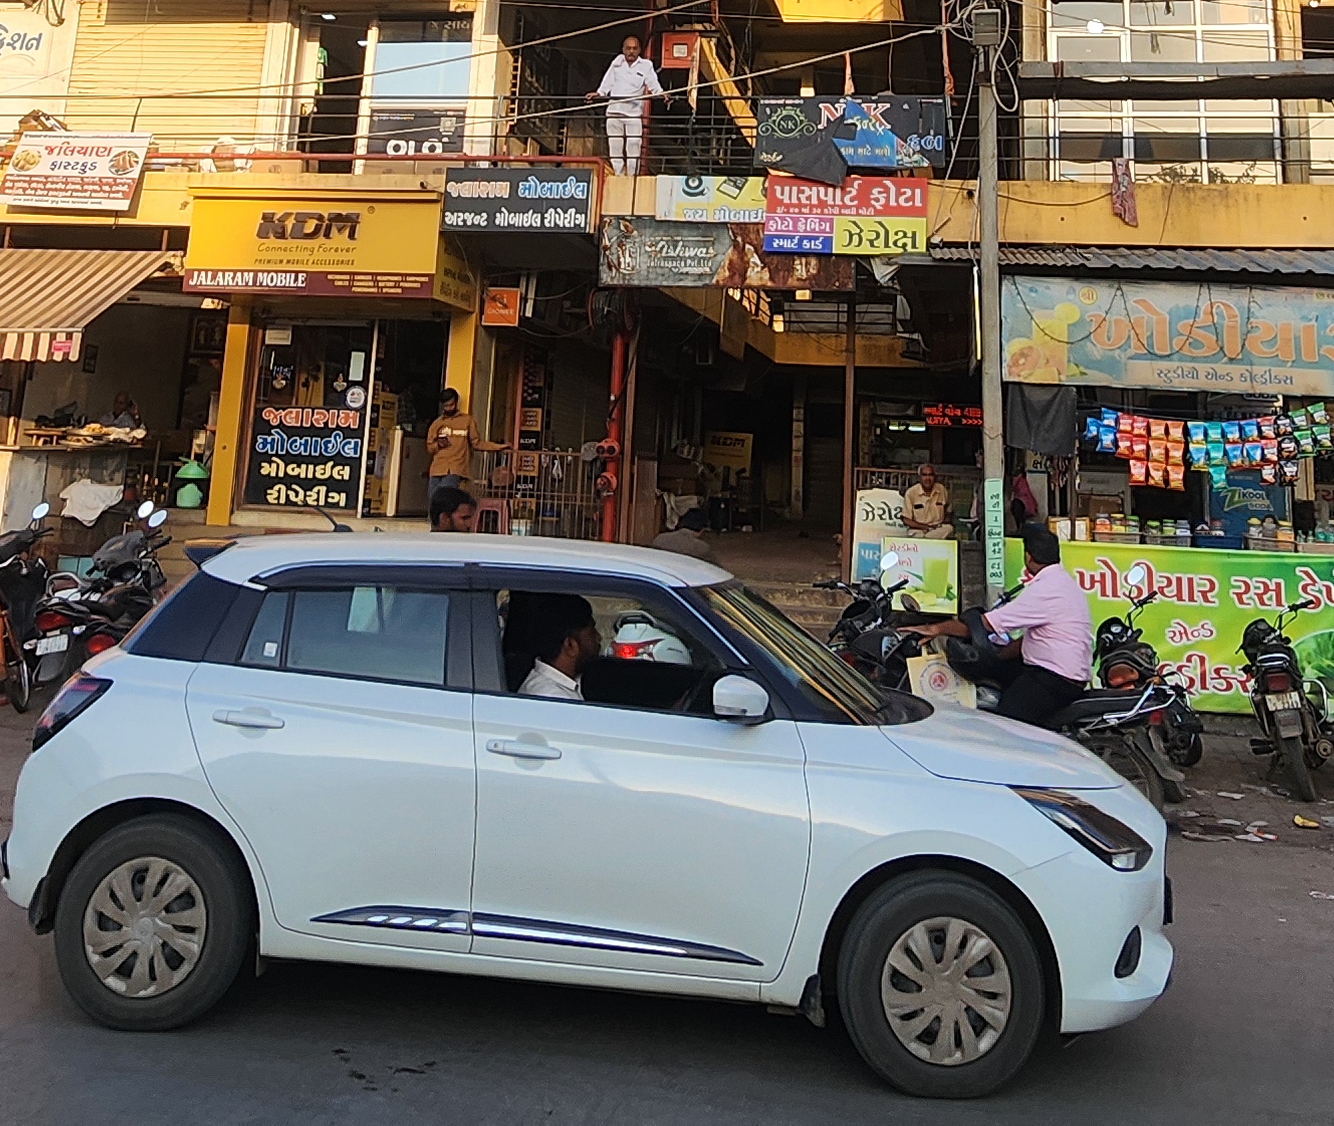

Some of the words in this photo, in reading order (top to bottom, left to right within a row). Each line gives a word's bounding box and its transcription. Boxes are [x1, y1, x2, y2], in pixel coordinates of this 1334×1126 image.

[780, 120, 796, 130] NK
[446, 180, 510, 199] જલારામ
[518, 175, 588, 199] મોબાઈલ
[444, 211, 488, 227] અરજન્ટ
[495, 207, 541, 228] મોબાઈલ
[683, 208, 708, 221] જય
[768, 216, 793, 232] ફોટો
[257, 211, 361, 241] KDM
[842, 220, 919, 252] ઝેરોક્ષ
[257, 243, 315, 255] Connecting
[317, 243, 357, 254] Forever
[772, 236, 800, 249] સ્માર્ટ
[802, 237, 824, 250] કાર્ડ
[254, 258, 283, 266] PREMIUM
[311, 259, 355, 267] ACCESSORIES
[189, 271, 255, 287] JALARAM
[256, 272, 307, 288] MOBILE
[1204, 369, 1234, 383] એન્ડ
[261, 407, 361, 429] જલારામ
[255, 429, 362, 458] મોબાઈલ
[260, 457, 351, 481] મોબાઈલ
[1230, 576, 1284, 609] રસ
[1166, 621, 1215, 645] એન્ડ
